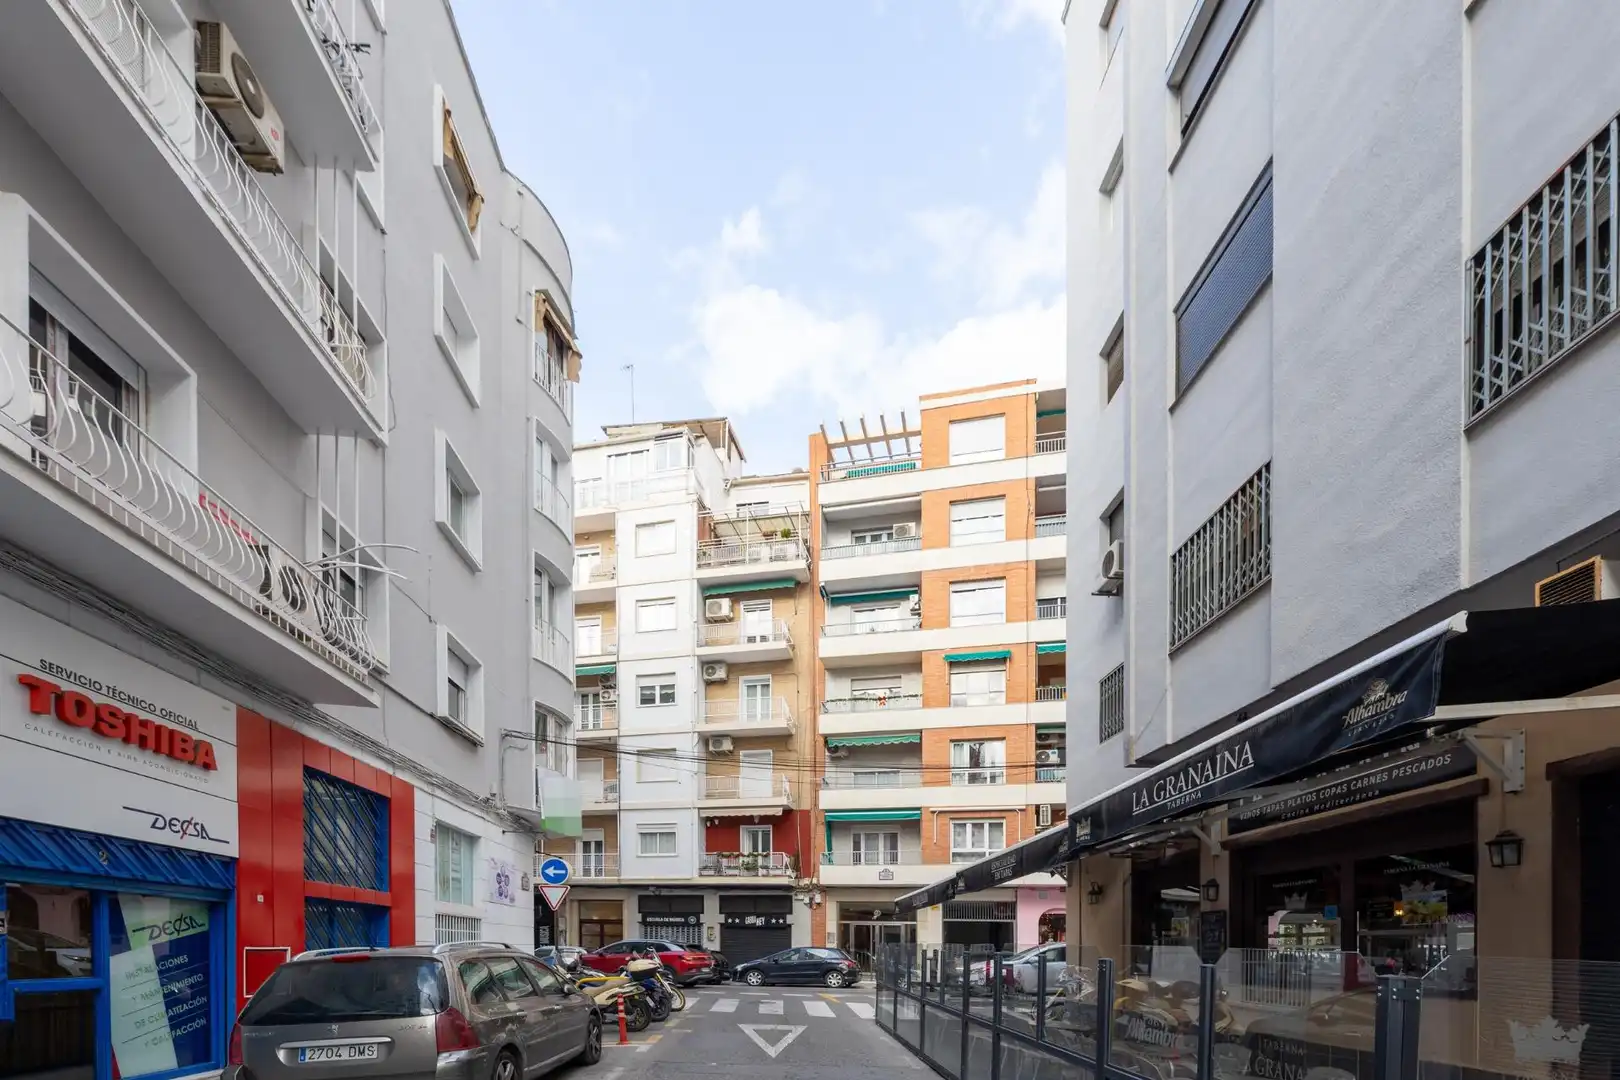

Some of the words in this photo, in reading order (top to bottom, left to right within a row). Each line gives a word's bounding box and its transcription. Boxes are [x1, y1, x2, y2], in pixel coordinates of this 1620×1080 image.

[39, 658, 103, 691] SERVICIO
[105, 685, 157, 713] TÉCNICO
[160, 707, 199, 730] OFICIAL
[1342, 690, 1408, 728] Alhambra
[17, 673, 218, 771] TOSHIBA
[24, 722, 102, 752] CALEFACCIÓN
[1132, 787, 1150, 812] LA
[1153, 740, 1255, 801] GRANAINA
[1240, 807, 1261, 820] VINOS
[1262, 801, 1285, 814] TAPAS
[1287, 792, 1317, 808] PLATOS
[1319, 783, 1348, 801] COPAS
[1350, 772, 1388, 795] CARNES
[1391, 754, 1452, 779] PESCADOS
[1166, 790, 1202, 811] TABERNA
[125, 954, 189, 981] INSTALACIONES
[308, 1047, 343, 1061] 2704
[348, 1044, 376, 1058] DMS
